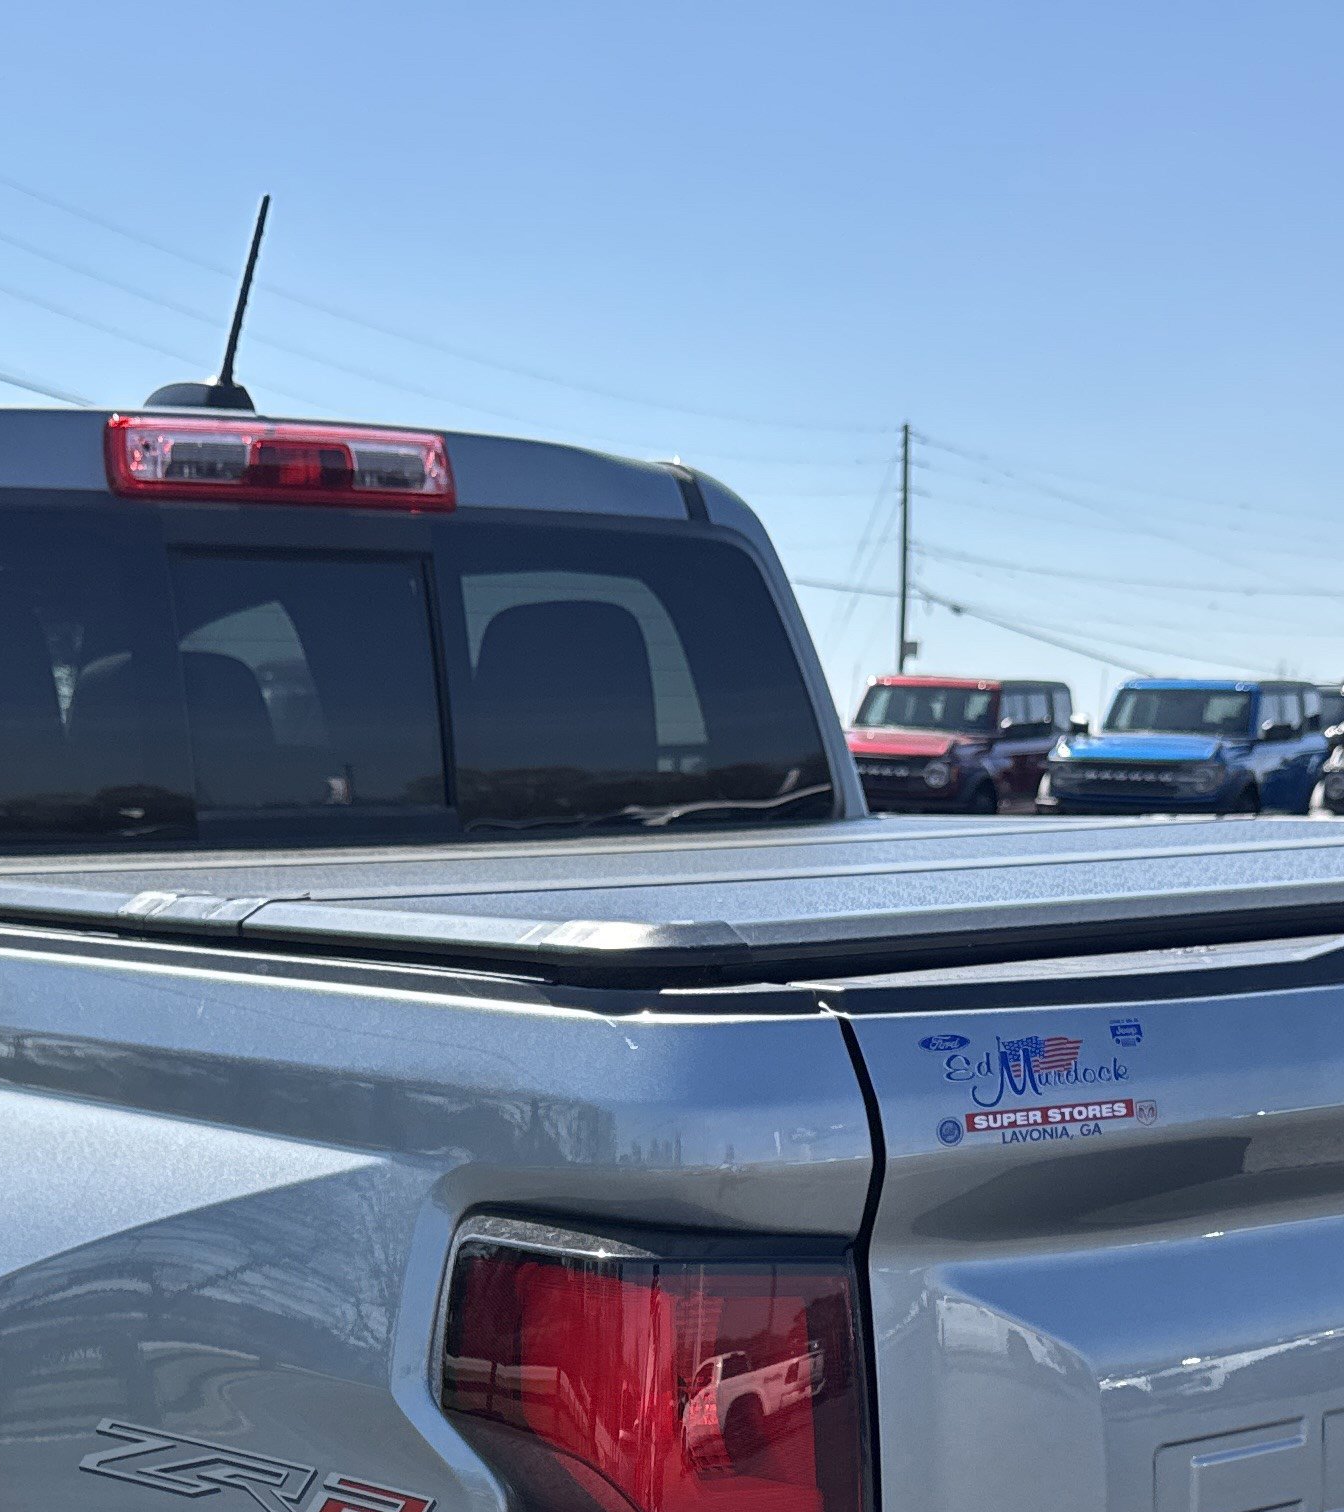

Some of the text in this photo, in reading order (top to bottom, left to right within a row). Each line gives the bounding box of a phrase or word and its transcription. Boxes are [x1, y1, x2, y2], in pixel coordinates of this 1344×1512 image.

[929, 1036, 961, 1050] Ford
[943, 1051, 993, 1082] Ed
[973, 1102, 1127, 1129] SUPER STORES
[1002, 1122, 1102, 1144] LAVONIA, GA
